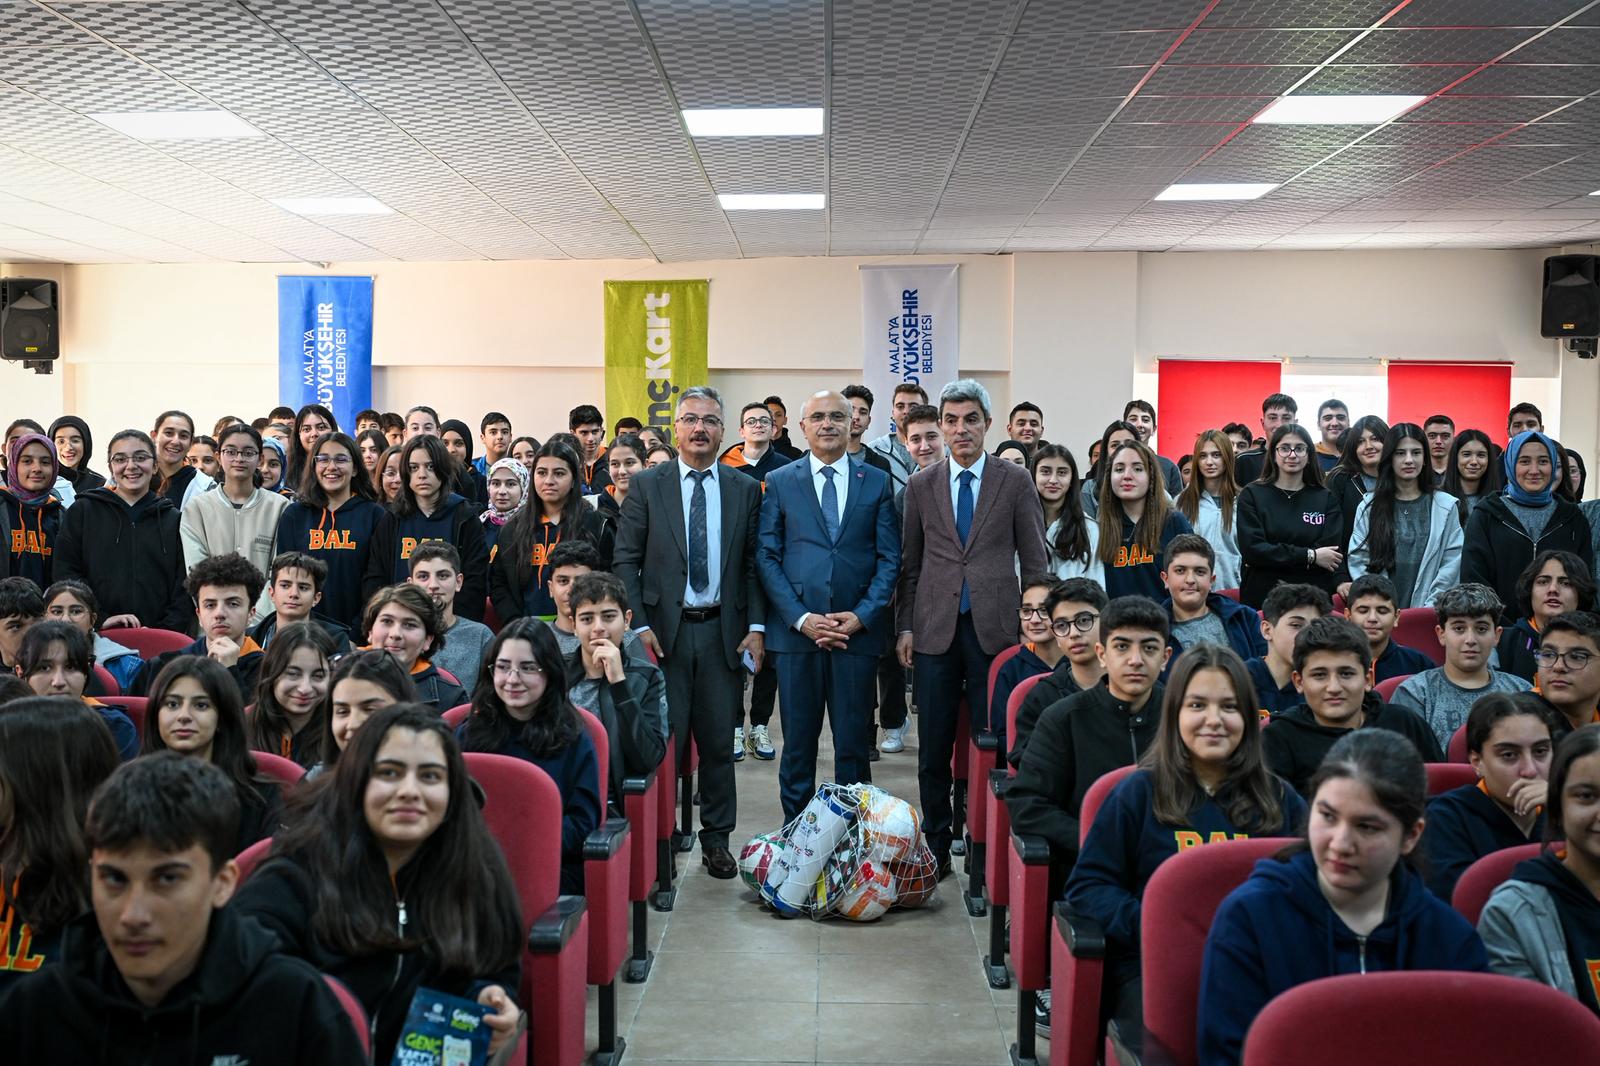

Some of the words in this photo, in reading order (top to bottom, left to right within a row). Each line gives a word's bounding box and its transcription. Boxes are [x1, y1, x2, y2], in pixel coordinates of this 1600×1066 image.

[303, 329, 314, 386] MALATYA
[888, 316, 899, 374] MALATYA
[902, 289, 920, 386] ÜYÜKŞEHİR
[921, 314, 932, 374] BELEDİYESİ
[11, 529, 52, 556] BAL
[309, 529, 356, 550] BAL
[1113, 543, 1154, 568] BAL
